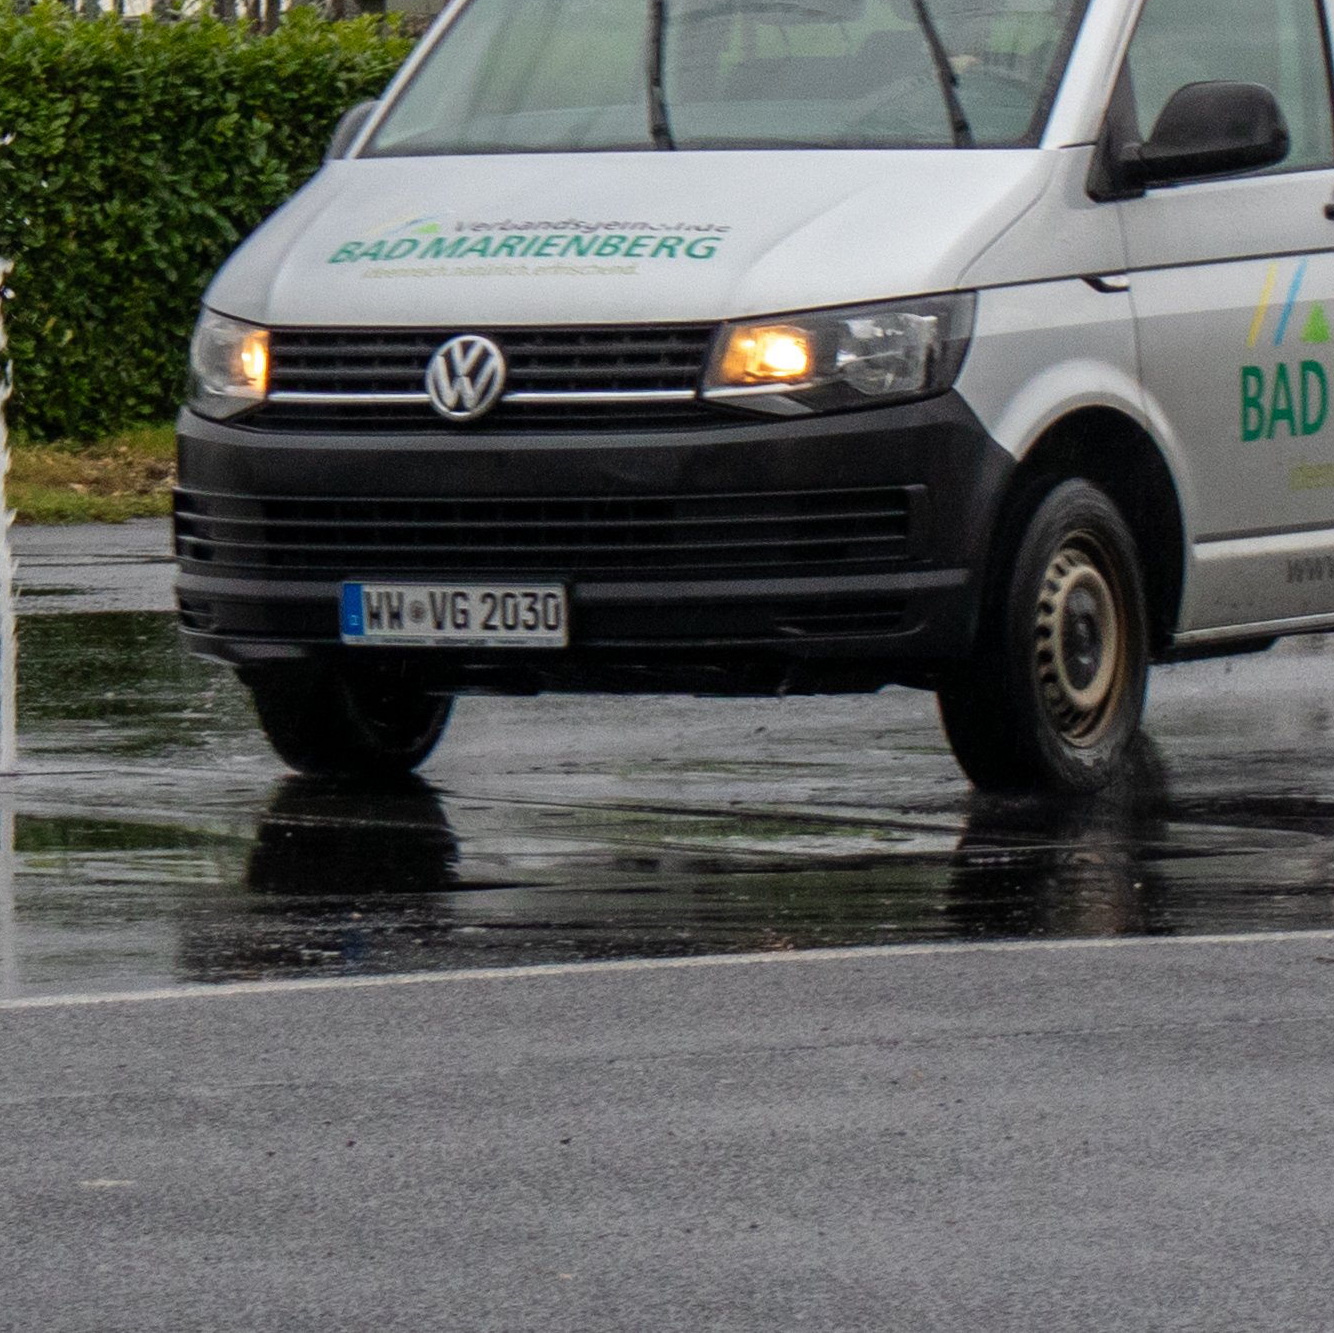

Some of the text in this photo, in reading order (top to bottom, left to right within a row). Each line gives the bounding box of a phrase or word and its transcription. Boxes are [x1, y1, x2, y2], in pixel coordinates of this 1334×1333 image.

[327, 234, 725, 264] BAD MARIENBERG
[1240, 358, 1330, 443] BAD
[363, 590, 561, 631] WW VG 2030
